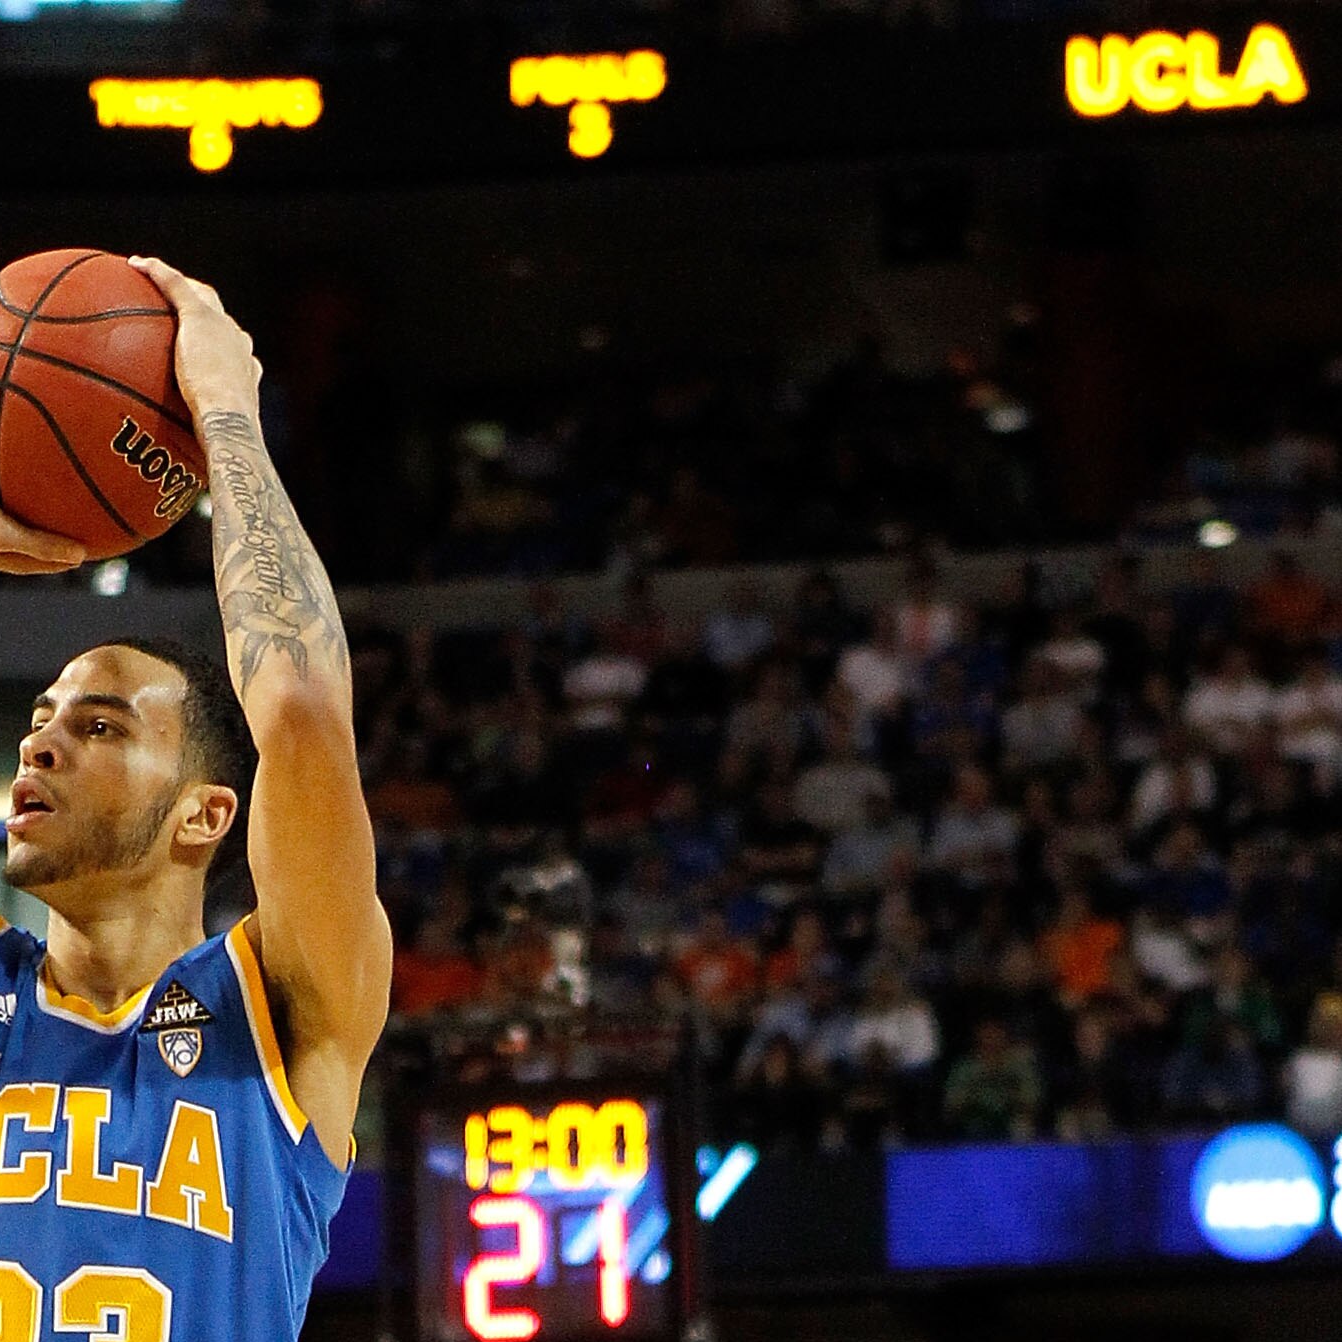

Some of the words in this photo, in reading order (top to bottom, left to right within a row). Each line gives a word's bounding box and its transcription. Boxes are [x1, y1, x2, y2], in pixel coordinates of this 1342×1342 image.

[1065, 20, 1309, 117] UCLA
[110, 415, 202, 521] lson
[151, 1002, 199, 1024] JRW
[464, 1099, 649, 1193] 13:00
[463, 1193, 630, 1342] 21
